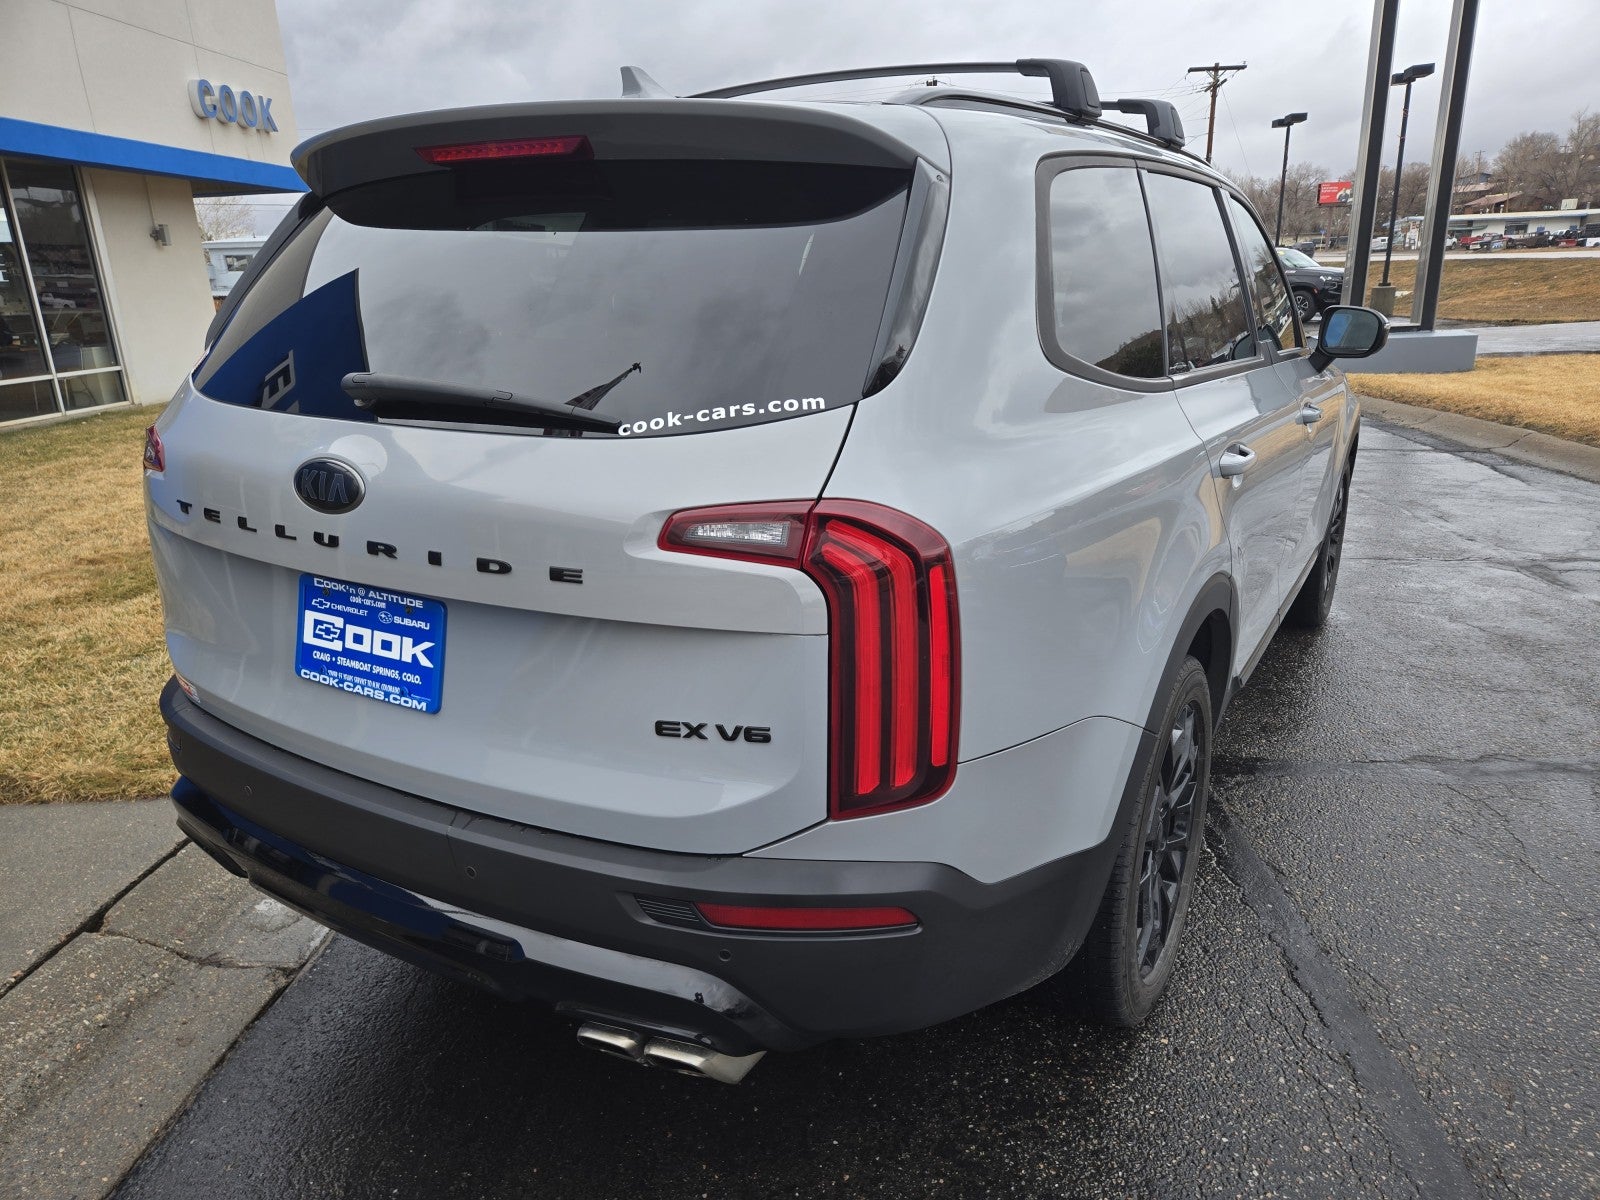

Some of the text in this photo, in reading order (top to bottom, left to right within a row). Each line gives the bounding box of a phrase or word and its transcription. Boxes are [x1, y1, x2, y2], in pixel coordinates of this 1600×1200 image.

[197, 79, 278, 132] COOK
[618, 397, 826, 436] cook-cars.com
[301, 468, 349, 503] KIA
[176, 499, 584, 585] TELLURIDE
[331, 603, 369, 617] CHEVROLET
[349, 595, 387, 609] cook-cars.com
[357, 587, 366, 597] @
[368, 590, 424, 608] ALTITUDE
[303, 609, 436, 669] COOK
[393, 616, 431, 630] SUBARU
[312, 650, 422, 685] CRAIG STEAMBOAT SPRINGS, COLO.
[300, 669, 427, 712] COOK-CARS.COM
[655, 720, 771, 743] EX V6
